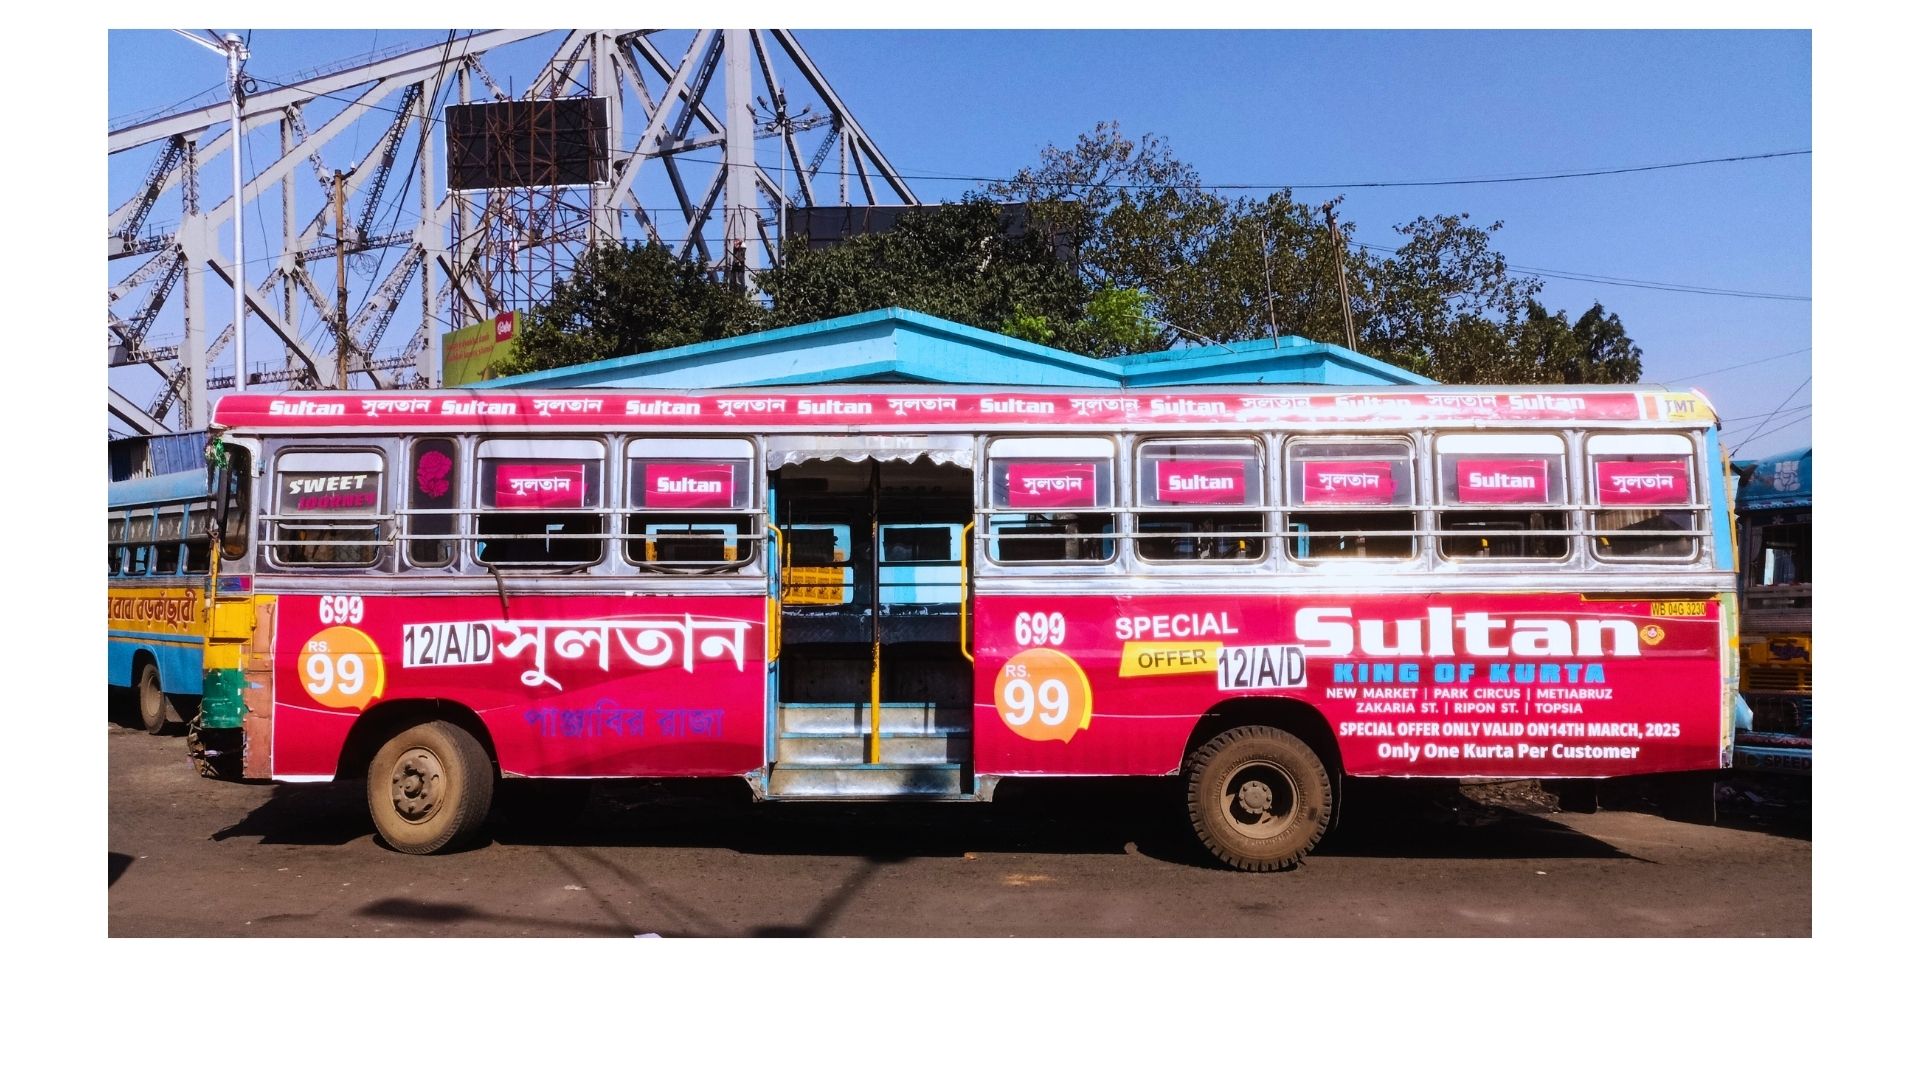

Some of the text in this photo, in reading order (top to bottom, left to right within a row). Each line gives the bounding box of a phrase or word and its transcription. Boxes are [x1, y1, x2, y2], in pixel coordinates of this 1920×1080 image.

[269, 400, 345, 417] Sultan
[362, 397, 430, 417] সুলতান
[441, 400, 516, 417] Sultan
[534, 397, 602, 417] সুলতান
[626, 399, 700, 416] Sultan
[717, 397, 786, 416] সুলতান
[797, 399, 872, 416] Sultan
[888, 396, 956, 416] সুলতান
[980, 398, 1055, 414] Sultan
[1071, 396, 1138, 416] সুলতান
[1150, 398, 1227, 416] Sultan
[1509, 394, 1585, 411] Sultan
[1666, 399, 1695, 413] TMT
[289, 475, 367, 495] SWEET
[509, 474, 571, 495] সুলতান
[656, 475, 722, 494] Sultan
[1022, 475, 1083, 495] সুলতান
[1169, 474, 1234, 491] Sultan
[1318, 471, 1380, 493] সুলতান
[1469, 472, 1535, 490] Sultan
[1612, 471, 1673, 494] সুলতান
[114, 596, 135, 620] বাবা
[319, 596, 364, 624] 699
[1652, 603, 1706, 615] WB 04G 3230
[1014, 612, 1066, 645] 699
[1115, 612, 1238, 640] SPECIAL
[1295, 606, 1640, 657] Sultan
[308, 641, 331, 652] RS.
[404, 624, 491, 665] 12/A/D
[497, 612, 752, 691] সুলতান
[1138, 648, 1207, 669] OFFER
[1218, 646, 1306, 688] 12/A/D
[306, 652, 364, 695] 99
[1005, 665, 1031, 678] RS.
[1334, 663, 1605, 683] KING OF KURTA
[1003, 678, 1069, 726] 99
[1326, 688, 1613, 699] NEW MARKET PARK CIRCUS METIABRUZ
[1356, 703, 1583, 714] ZAKARIA ST. RIPON ST. TOPSIA
[656, 707, 725, 738] রাজা
[1340, 722, 1394, 736] SPECIAL
[1397, 722, 1439, 736] OFFER
[1442, 722, 1481, 736] ONLY
[1483, 722, 1524, 737] VALID
[1588, 723, 1643, 739] MARCH,
[1645, 723, 1680, 737] 2025
[1378, 742, 1640, 762] Only One Kurta Per Customer
